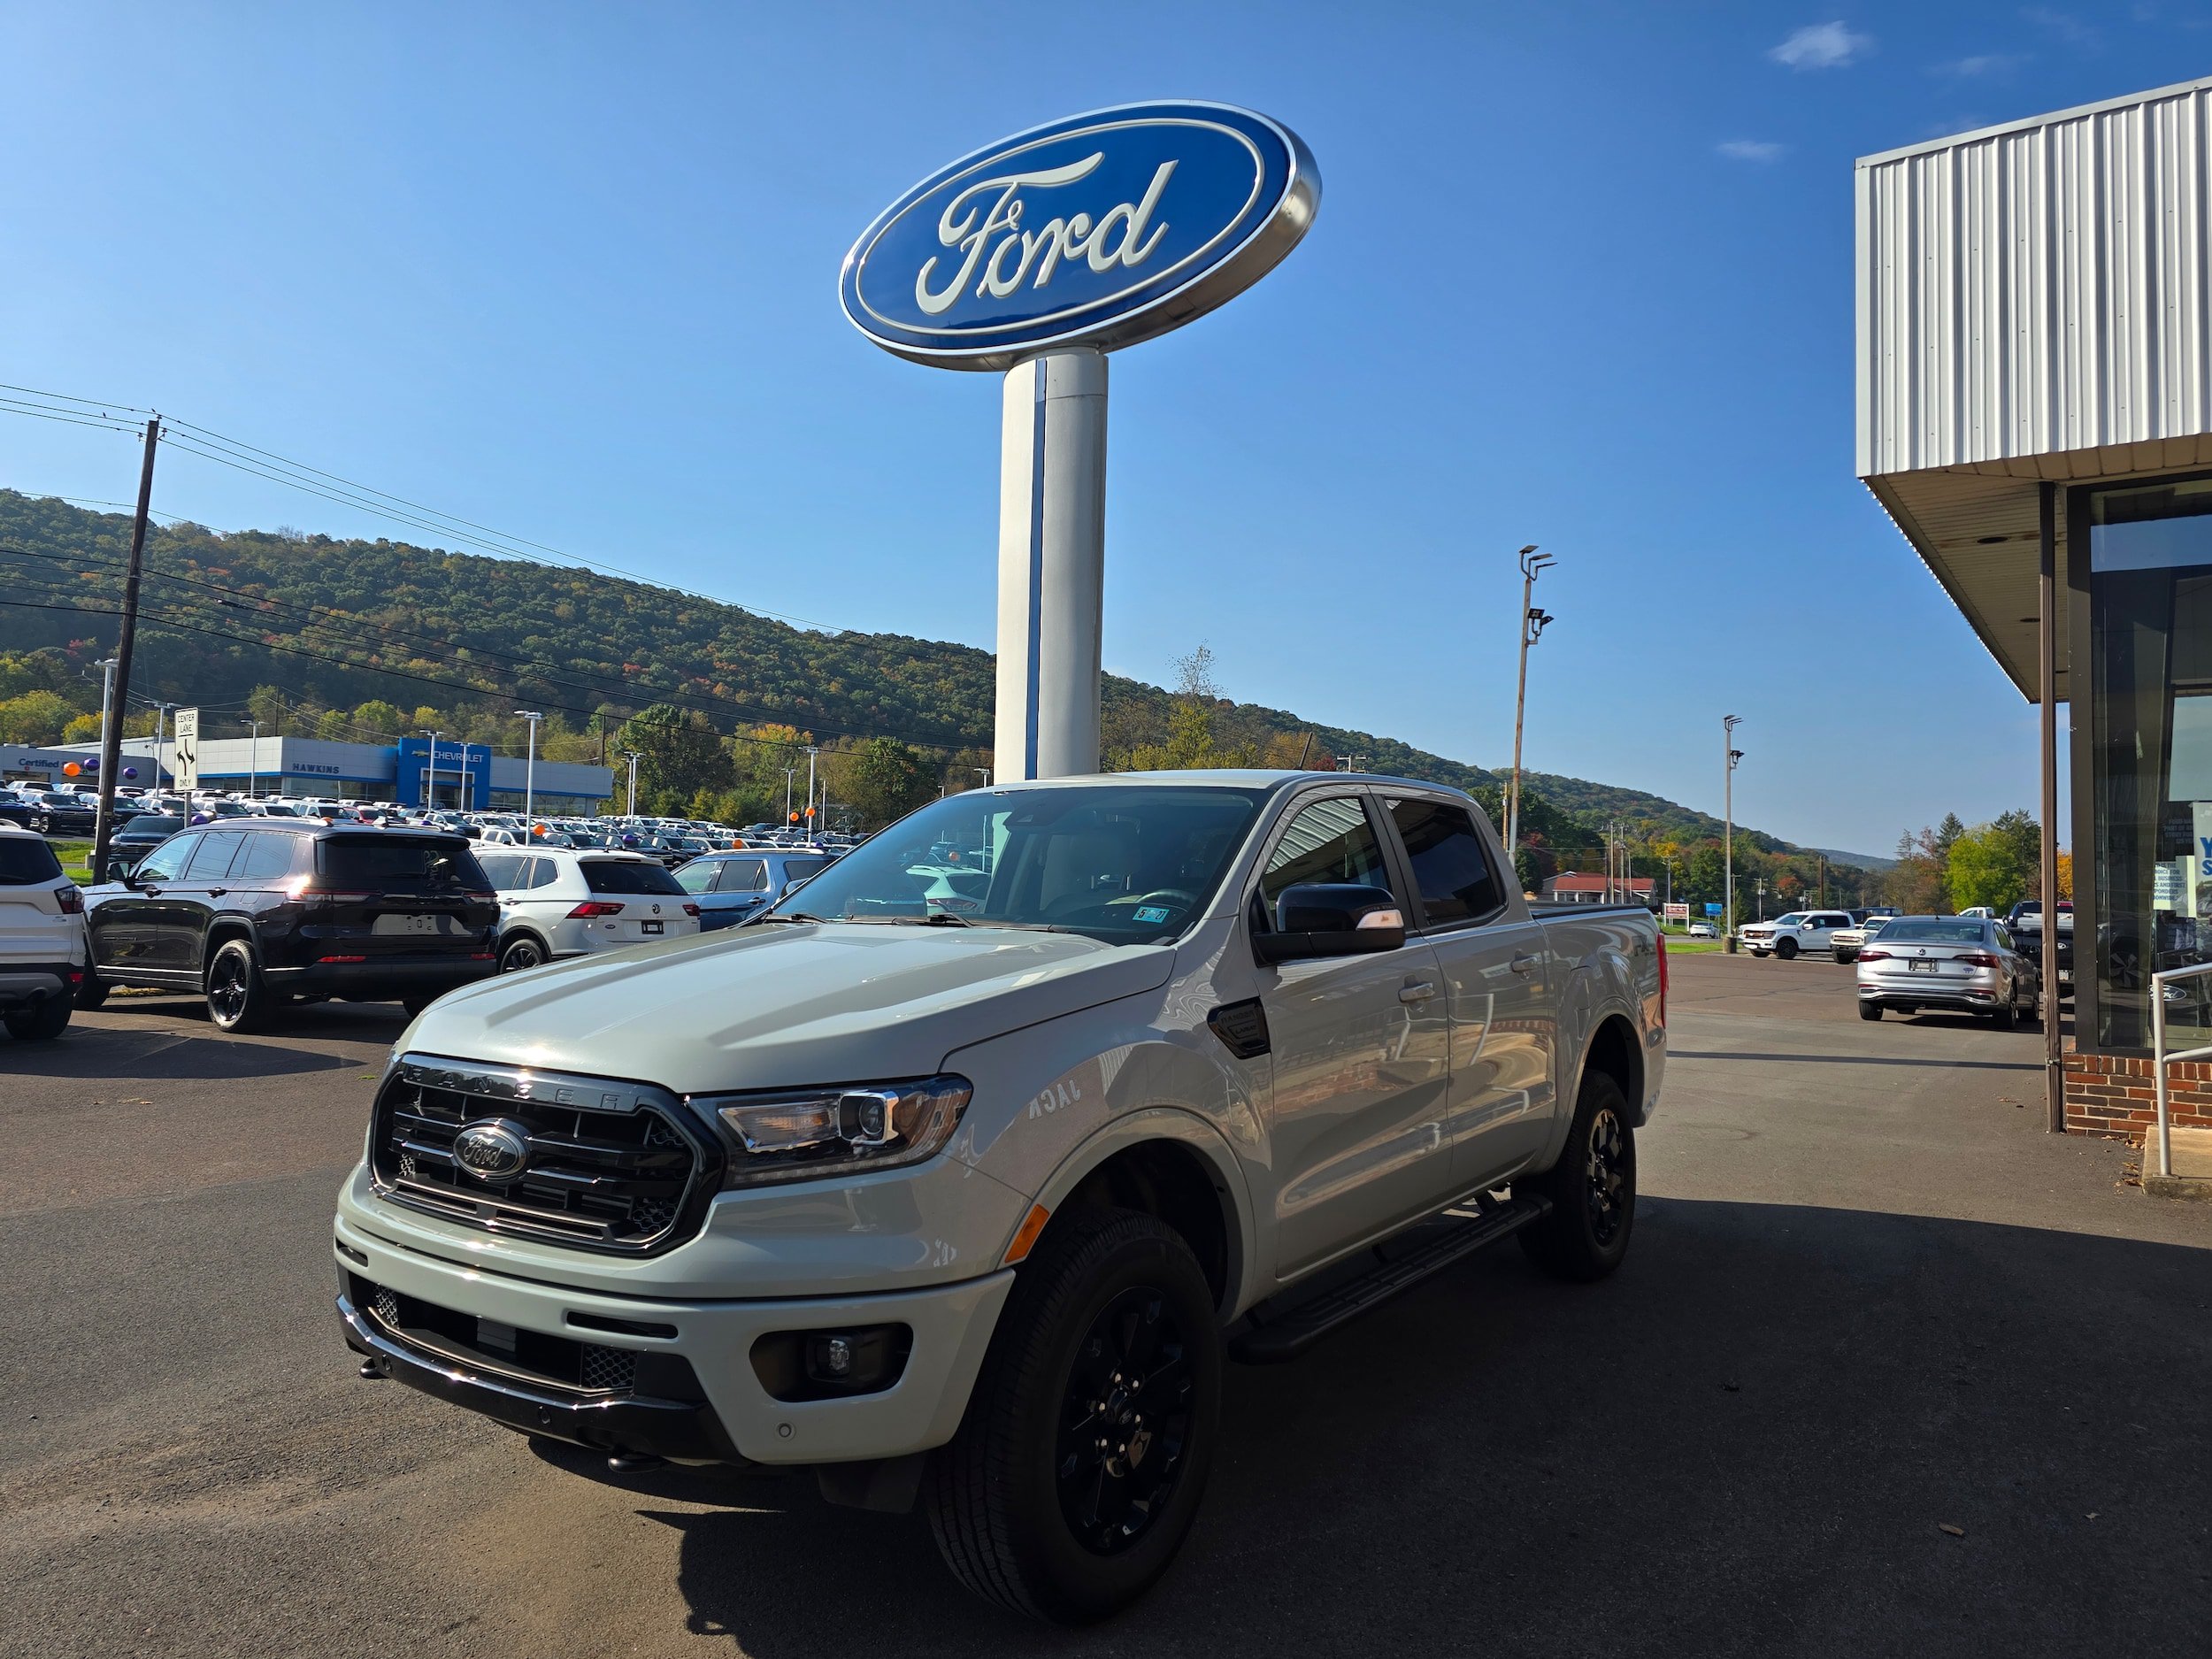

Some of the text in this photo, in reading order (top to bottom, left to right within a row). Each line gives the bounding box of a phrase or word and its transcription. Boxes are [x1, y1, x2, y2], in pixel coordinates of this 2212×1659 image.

[915, 150, 1179, 316] Ford
[177, 713, 195, 723] CENTER
[180, 724, 192, 733] LANE
[433, 750, 484, 763] CHEVROLET
[19, 758, 59, 768] Certified
[292, 763, 340, 774] HAWKINS
[407, 1067, 621, 1110] RANGER
[463, 1133, 504, 1168] Ford
